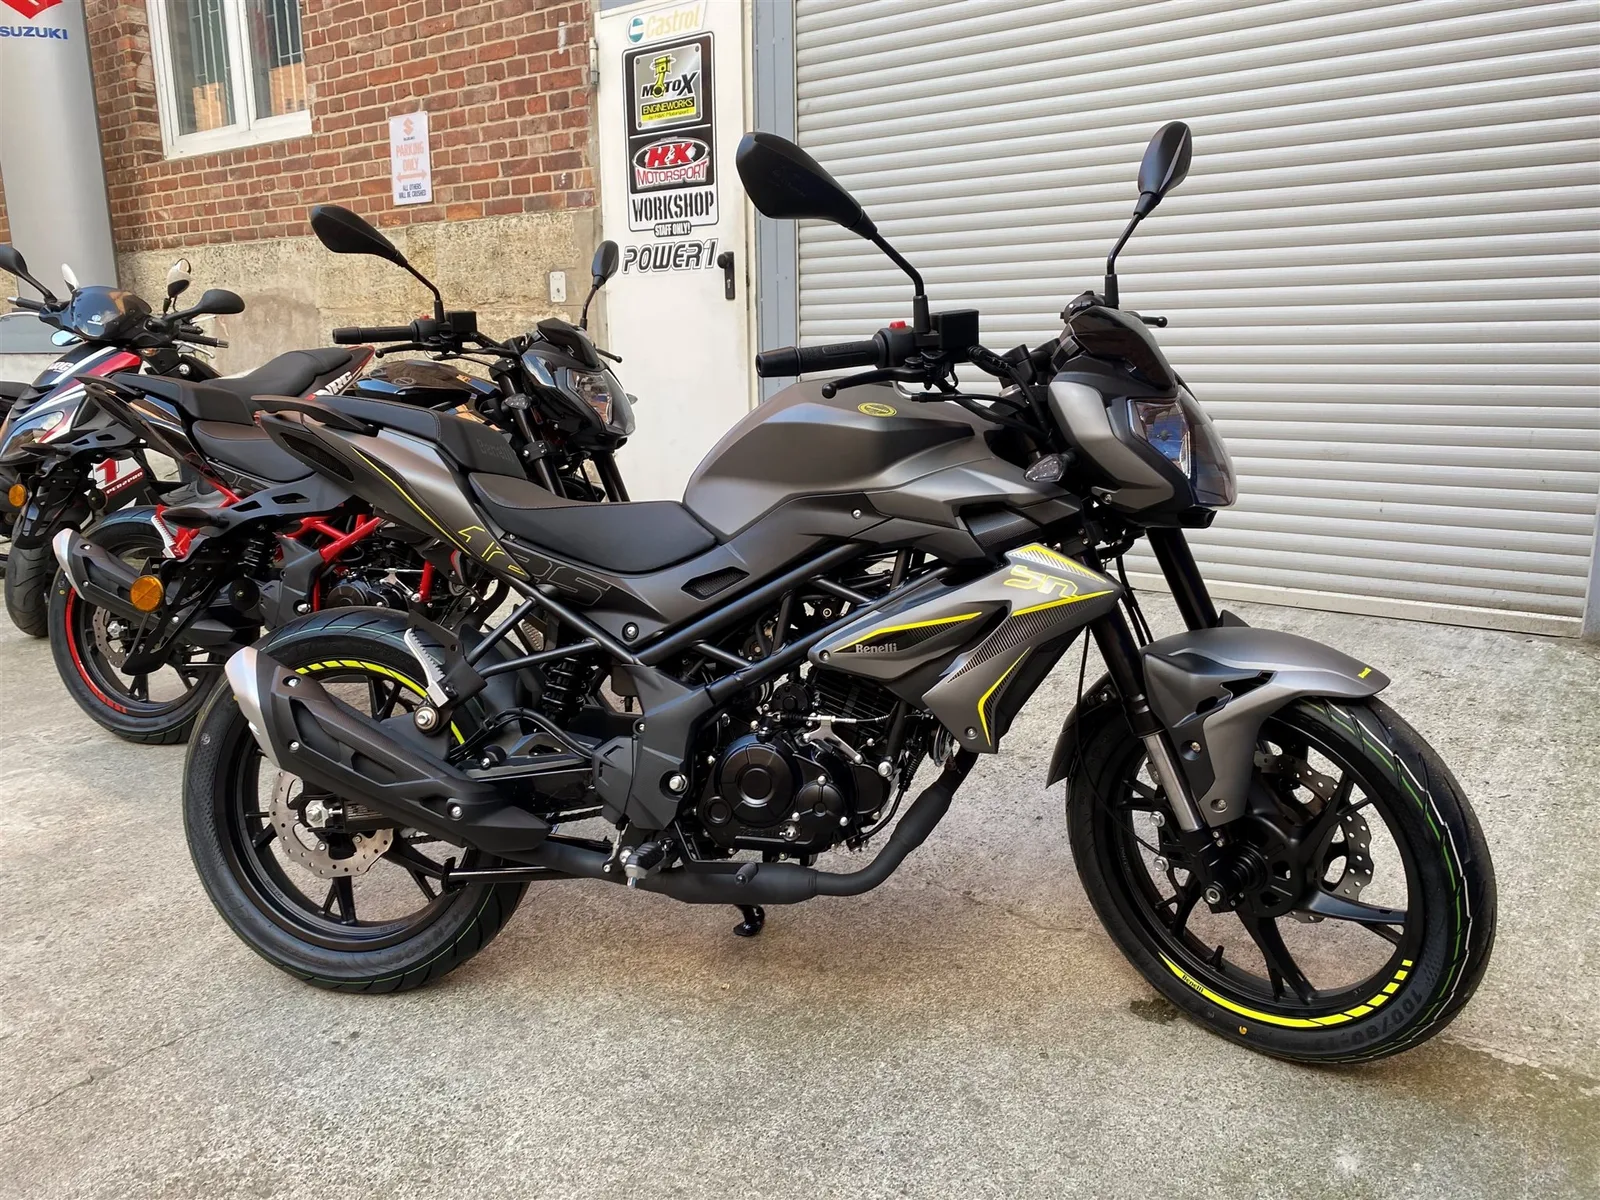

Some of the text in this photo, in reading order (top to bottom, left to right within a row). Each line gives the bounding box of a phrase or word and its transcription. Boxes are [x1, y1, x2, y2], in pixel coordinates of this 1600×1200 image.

[646, 3, 700, 38] Castrol
[0, 26, 68, 39] SUZUKI
[642, 98, 693, 115] ENGINEWORKS
[396, 142, 424, 157] PARKING
[403, 158, 419, 171] ONLY
[636, 161, 708, 186] MOTORSPORT
[632, 191, 714, 222] WORKSHOP
[655, 222, 691, 236] STAFF ONLY!
[622, 239, 718, 273] POWER1
[855, 643, 898, 654] Benelli
[1181, 974, 1204, 993] Benelli
